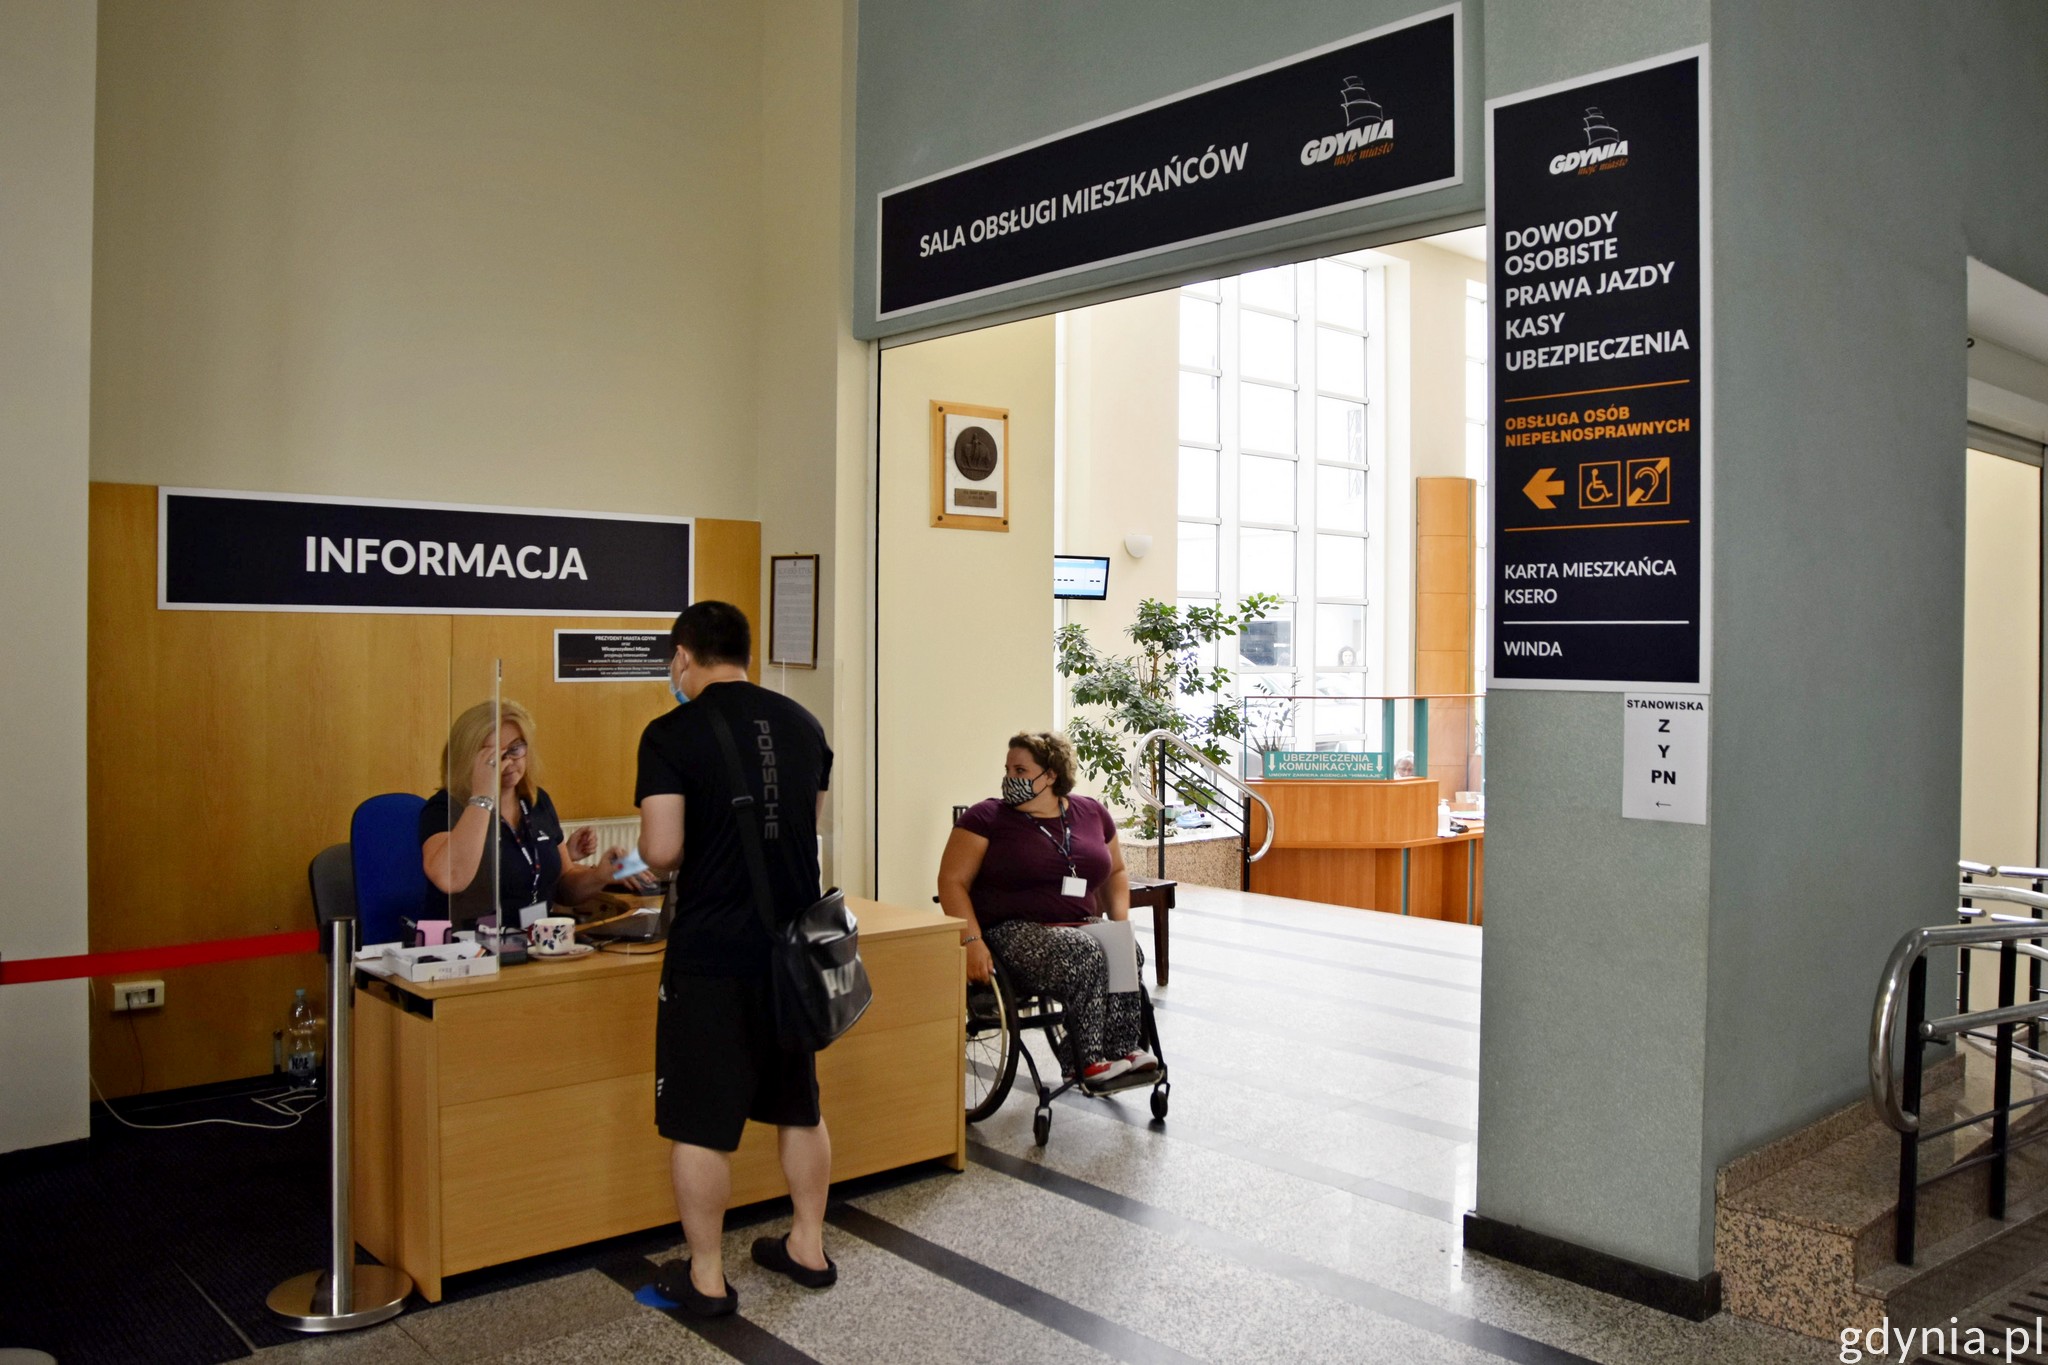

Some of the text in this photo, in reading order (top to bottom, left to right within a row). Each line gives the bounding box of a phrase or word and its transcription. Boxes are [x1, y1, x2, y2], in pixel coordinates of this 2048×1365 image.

[1300, 119, 1394, 166] GDYNIA
[1333, 142, 1394, 166] moje miasto
[1549, 140, 1628, 175] GDYNIA
[919, 142, 1249, 258] SALA OBSŁUGI MIESZKAŃCÓW
[1505, 211, 1618, 251] DOWODY
[1504, 237, 1618, 276] OSOBISTE
[1505, 261, 1675, 308] PRAWA JAZDY
[1505, 312, 1566, 340] KASY
[1505, 329, 1690, 371] UBEZPIECZENIA
[1505, 404, 1630, 431] OBSŁUGA OSÓB
[1505, 418, 1690, 447] NIEPEŁNOSPRAWNYCH
[305, 536, 588, 581] INFORMACJA
[1504, 556, 1677, 579] KARTA MIESZKAŃCA
[1504, 588, 1558, 604] KSERO
[1503, 641, 1563, 657] WINDA
[1626, 699, 1704, 711] STANOWISKA
[1658, 719, 1670, 733] Z
[1283, 753, 1370, 762] UBEZPIECZENIA
[1658, 744, 1670, 758] Y
[753, 719, 779, 839] PORSCHE
[1279, 762, 1374, 771] KOMUNIKACYJNE
[1651, 769, 1676, 785] PN
